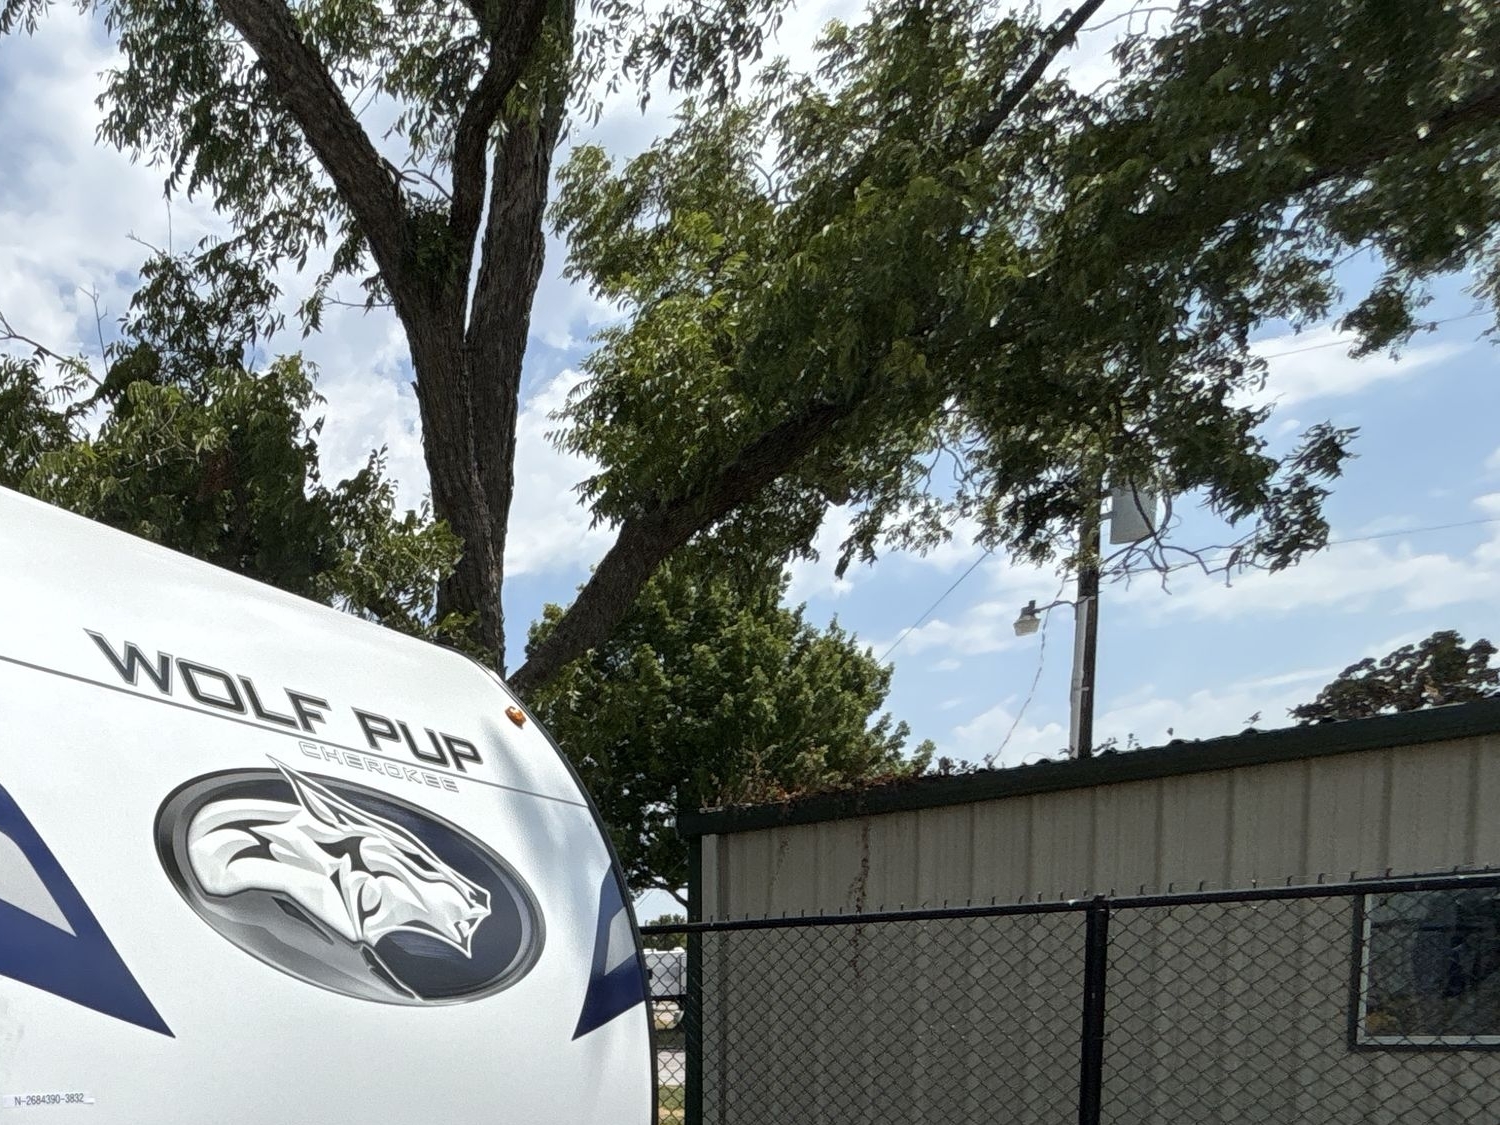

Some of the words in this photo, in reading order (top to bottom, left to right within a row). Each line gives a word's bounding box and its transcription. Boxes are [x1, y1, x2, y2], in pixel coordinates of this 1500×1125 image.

[83, 627, 331, 734] WOLF
[352, 706, 484, 773] PUP
[297, 740, 460, 793] CHEROKEE
[14, 1093, 84, 1106] N-2684390-3832
